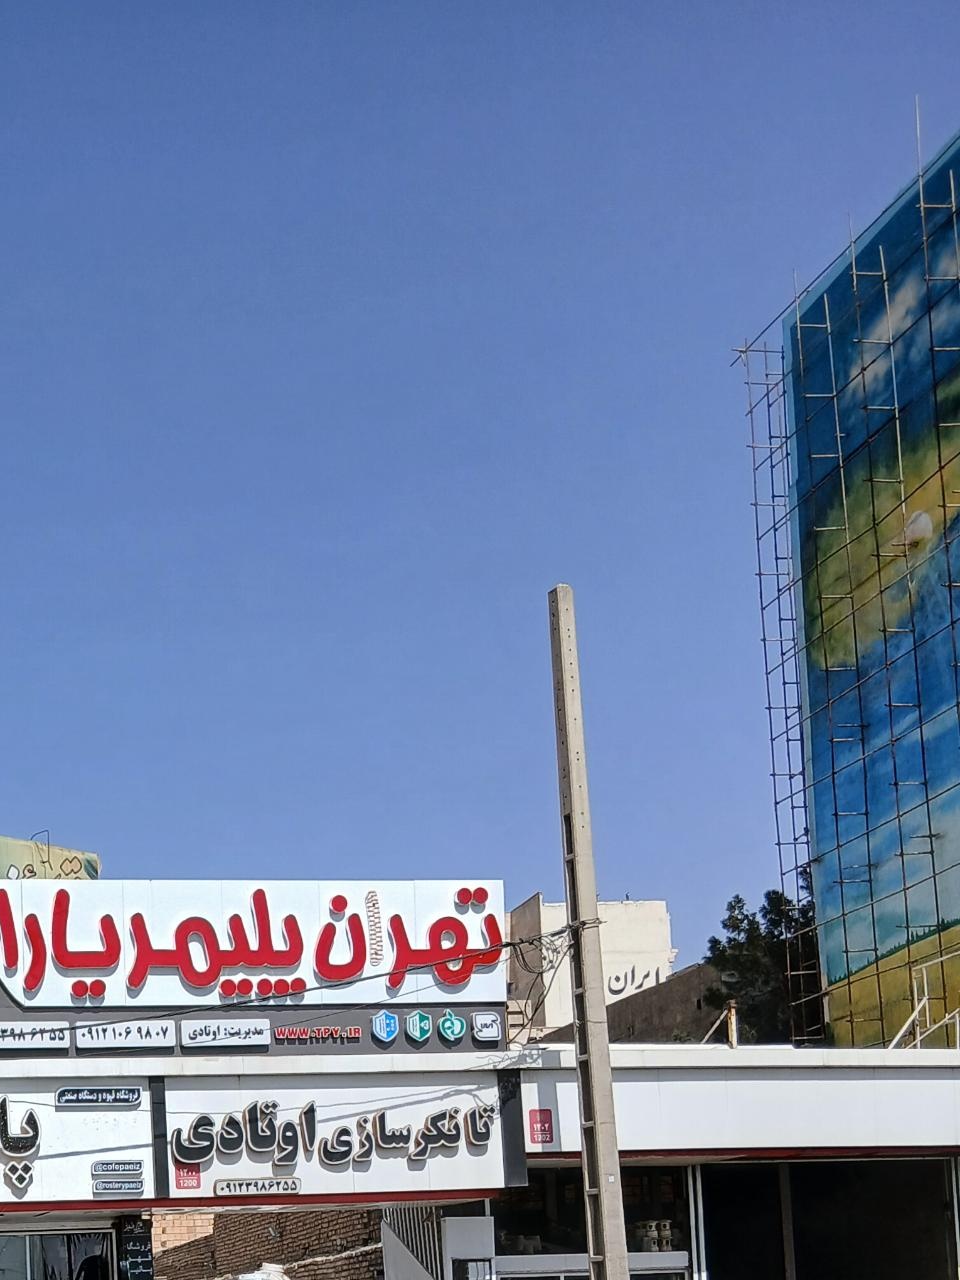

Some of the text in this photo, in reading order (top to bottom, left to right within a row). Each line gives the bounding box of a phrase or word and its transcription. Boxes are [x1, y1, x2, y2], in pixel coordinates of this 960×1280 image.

[127, 888, 307, 997] پلیمر
[314, 887, 503, 989] تهران
[189, 1025, 220, 1042] اوتادی
[171, 1100, 318, 1165] اوتادی
[179, 1179, 197, 1187] 1200
